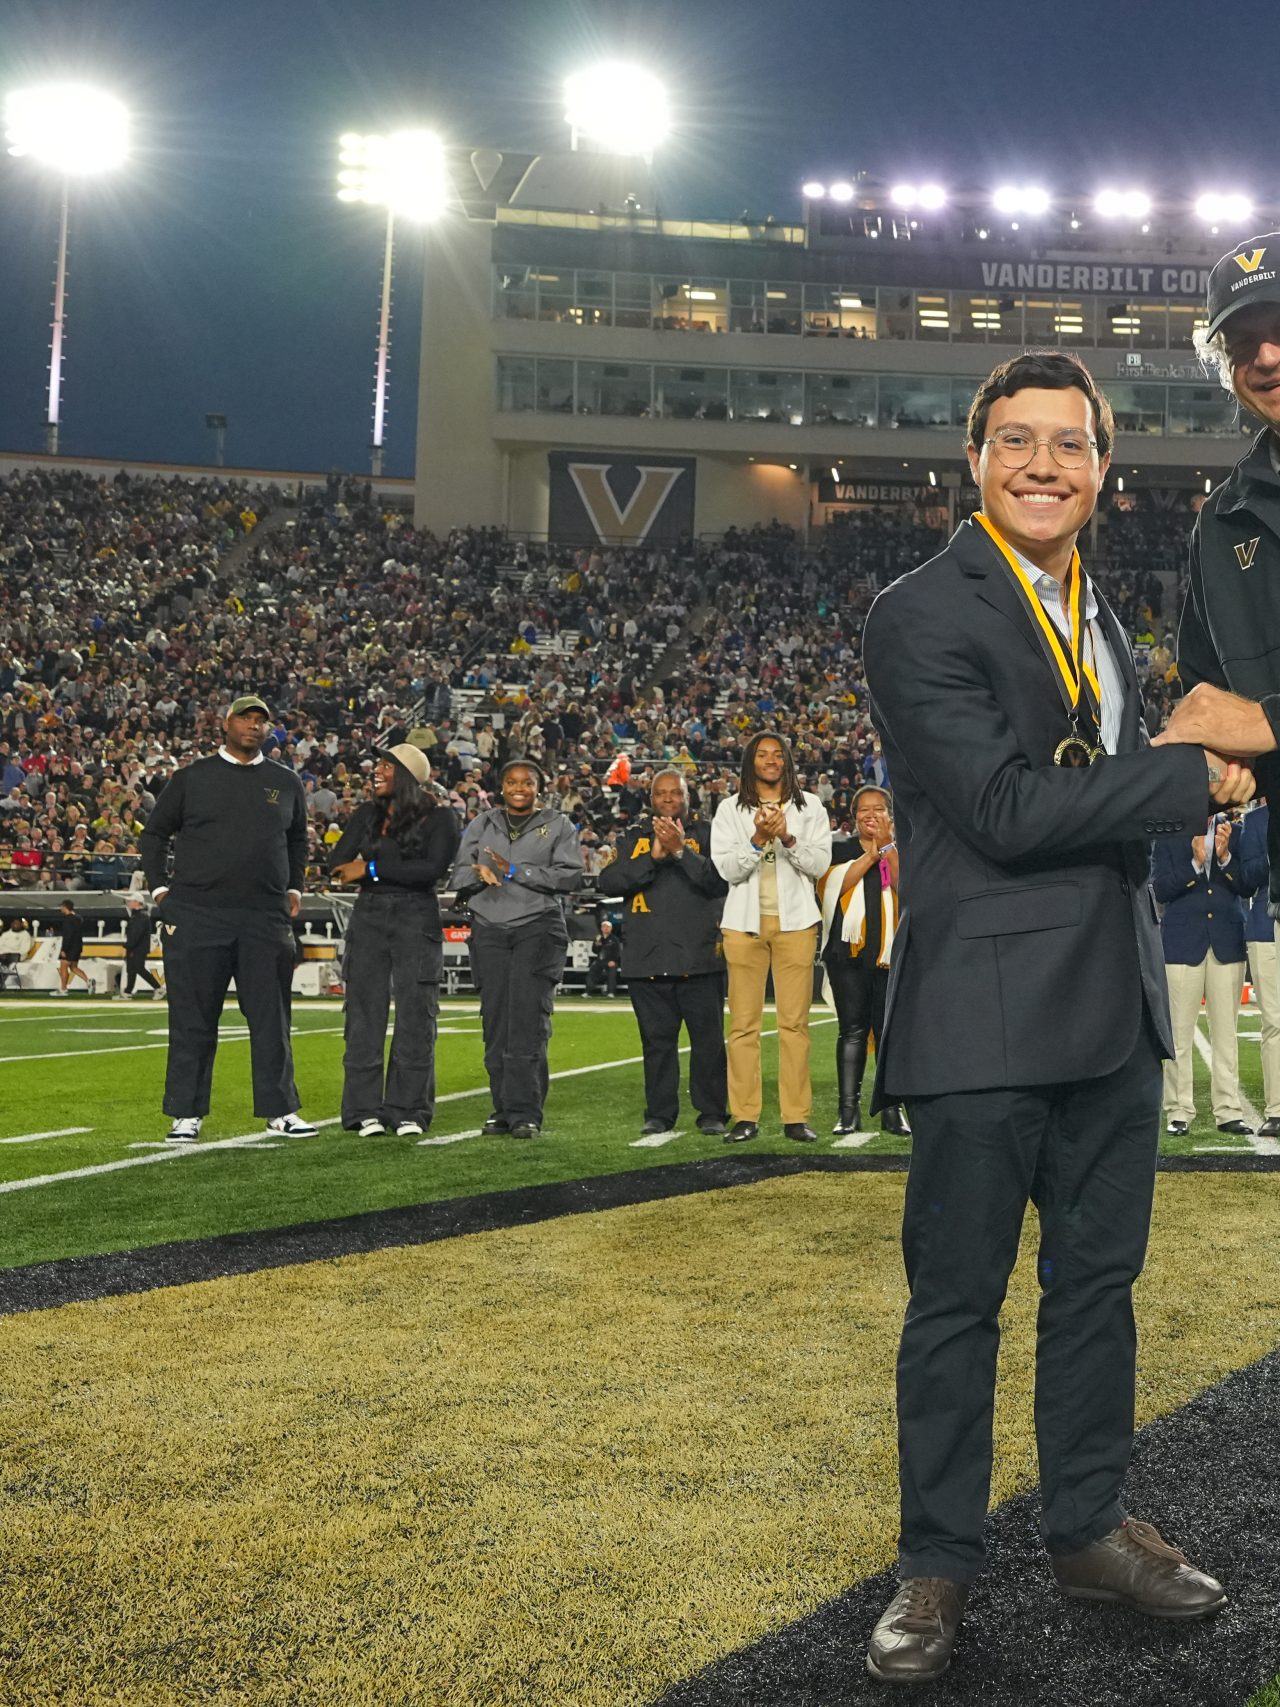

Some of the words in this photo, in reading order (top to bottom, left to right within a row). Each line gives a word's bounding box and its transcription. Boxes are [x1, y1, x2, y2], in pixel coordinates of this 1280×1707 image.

[982, 262, 1154, 292] VANDERBILT
[1230, 271, 1276, 292] VANDERBILT
[568, 463, 685, 546] V
